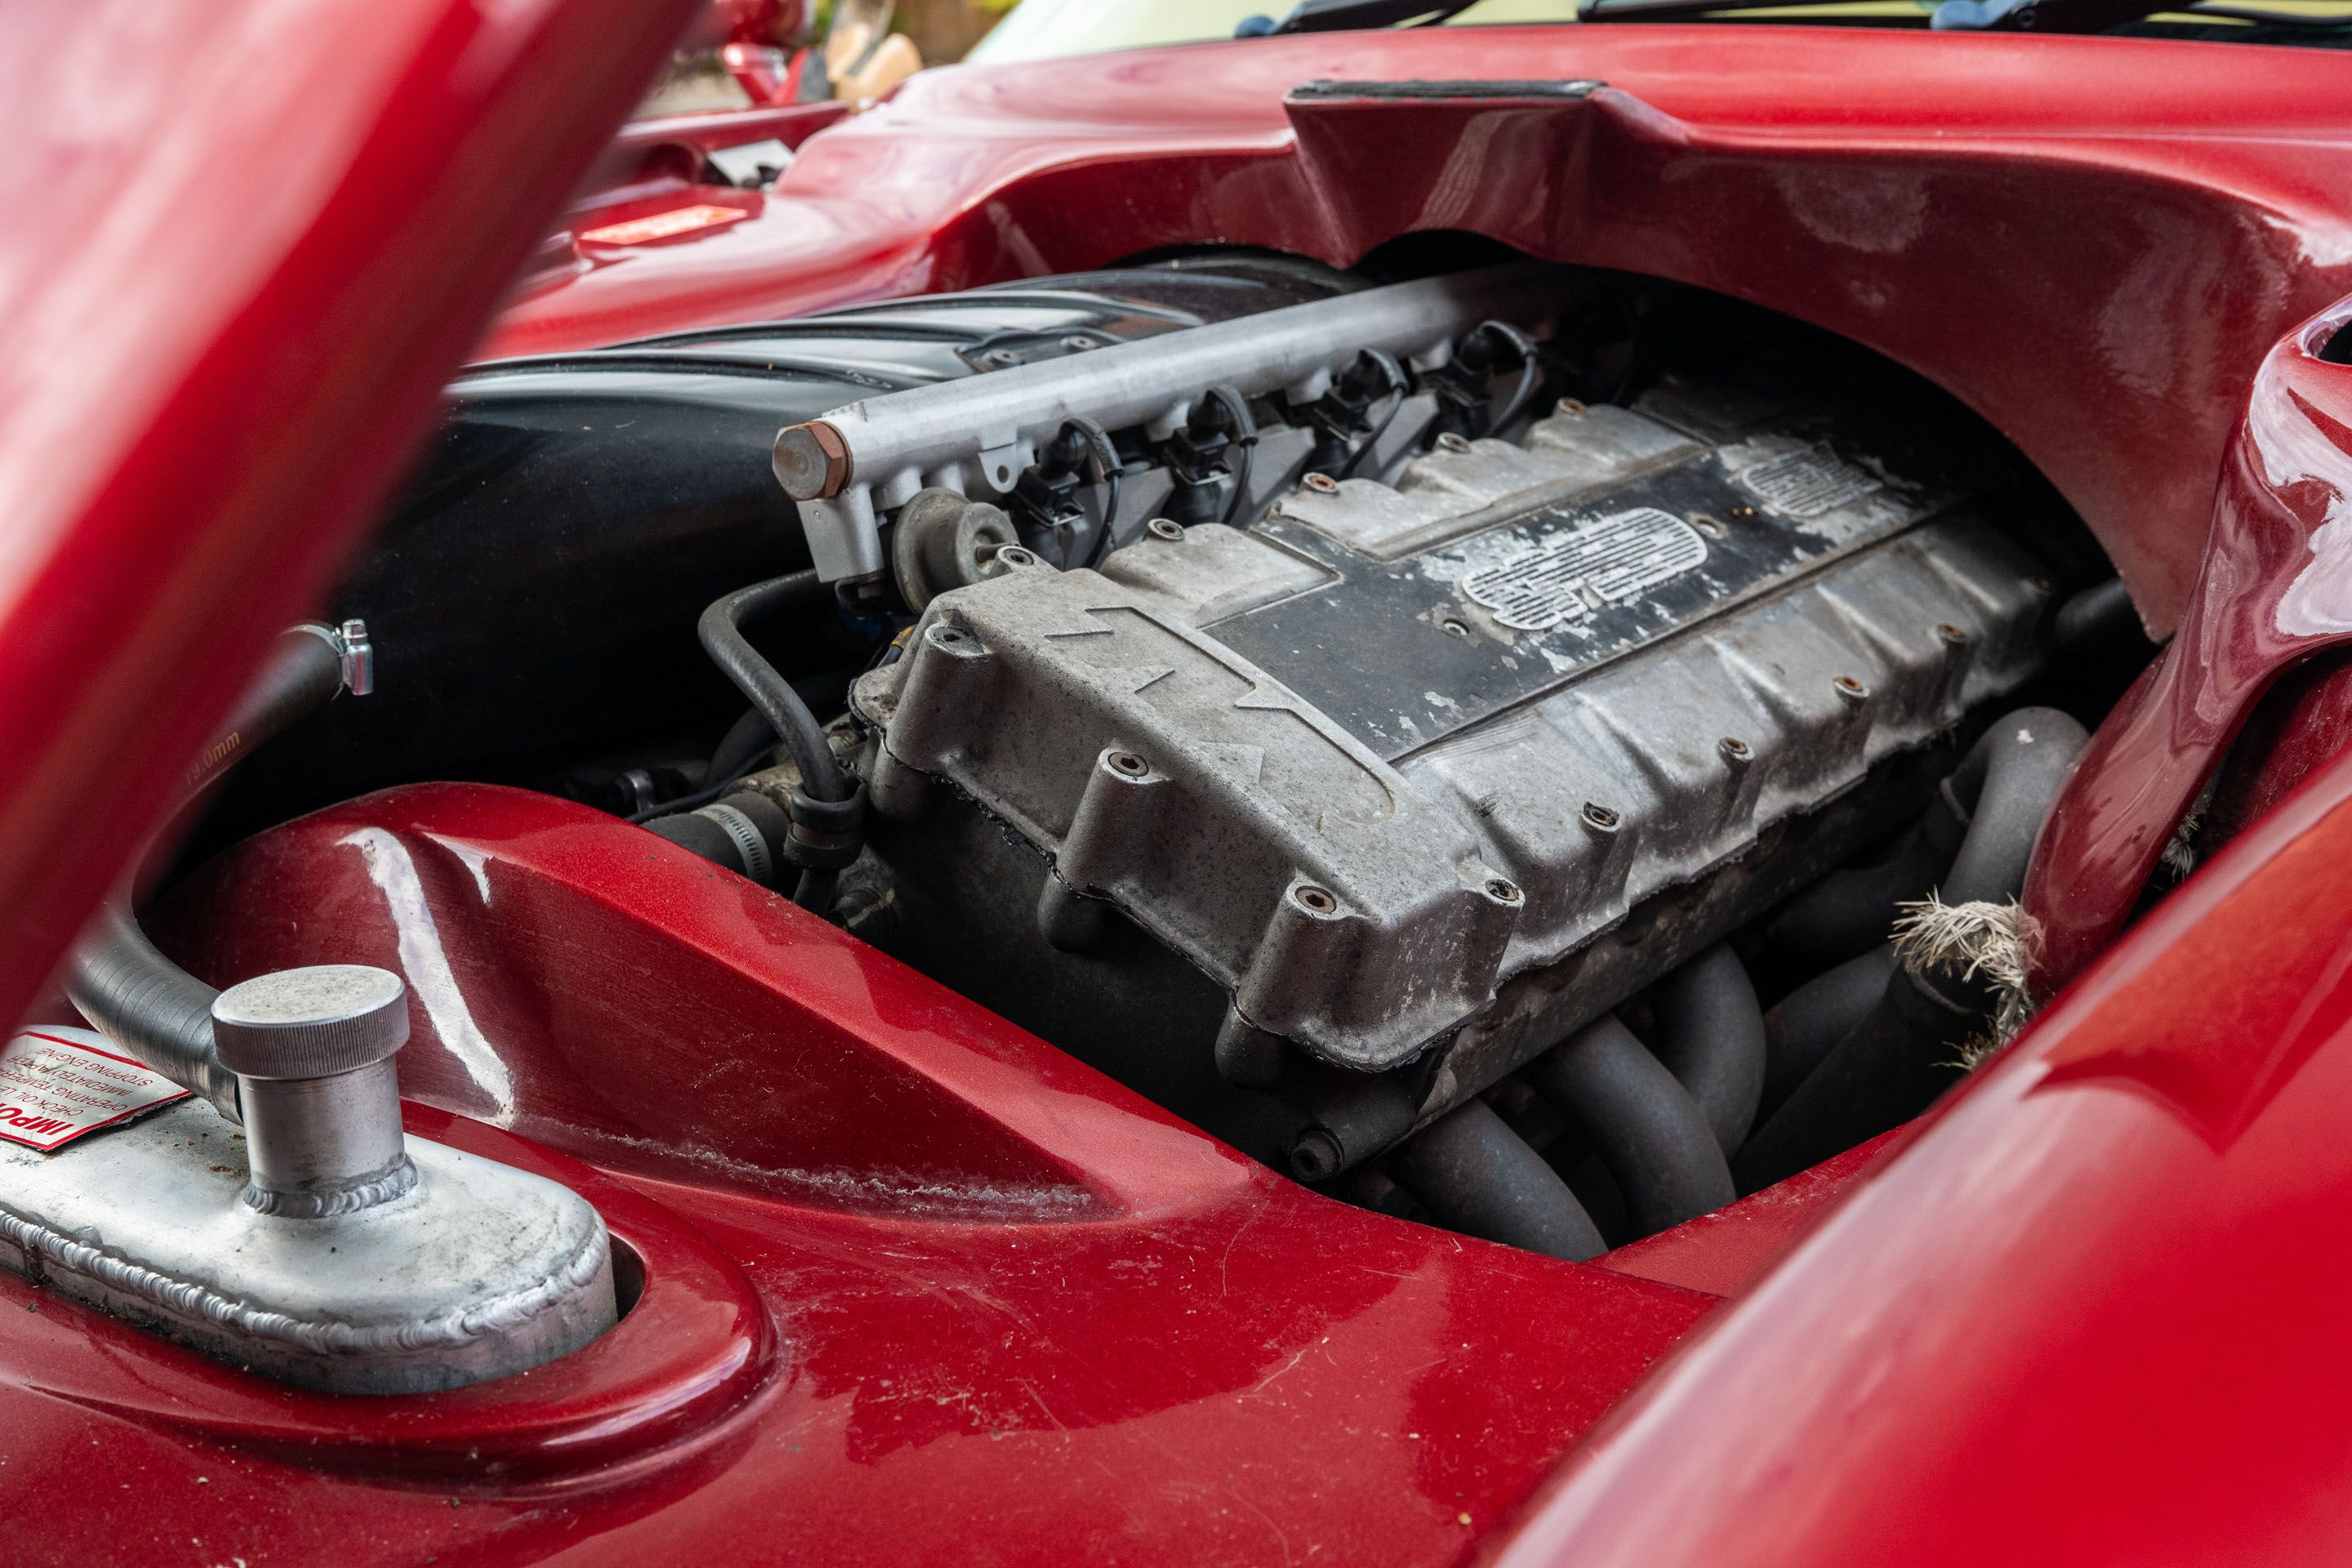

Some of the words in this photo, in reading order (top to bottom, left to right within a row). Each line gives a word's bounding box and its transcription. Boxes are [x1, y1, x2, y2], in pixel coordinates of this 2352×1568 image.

[1462, 507, 1708, 630] SPEED
[1044, 607, 1396, 834] TVR
[7, 1056, 50, 1073] AFTER
[84, 1062, 154, 1087] STOPPING
[50, 1069, 133, 1097] IMMEDIATELY
[14, 1091, 38, 1102] OIL
[33, 1099, 83, 1116] CHECK
[51, 1087, 128, 1111] OPERATING
[0, 1103, 75, 1136] IMPO
